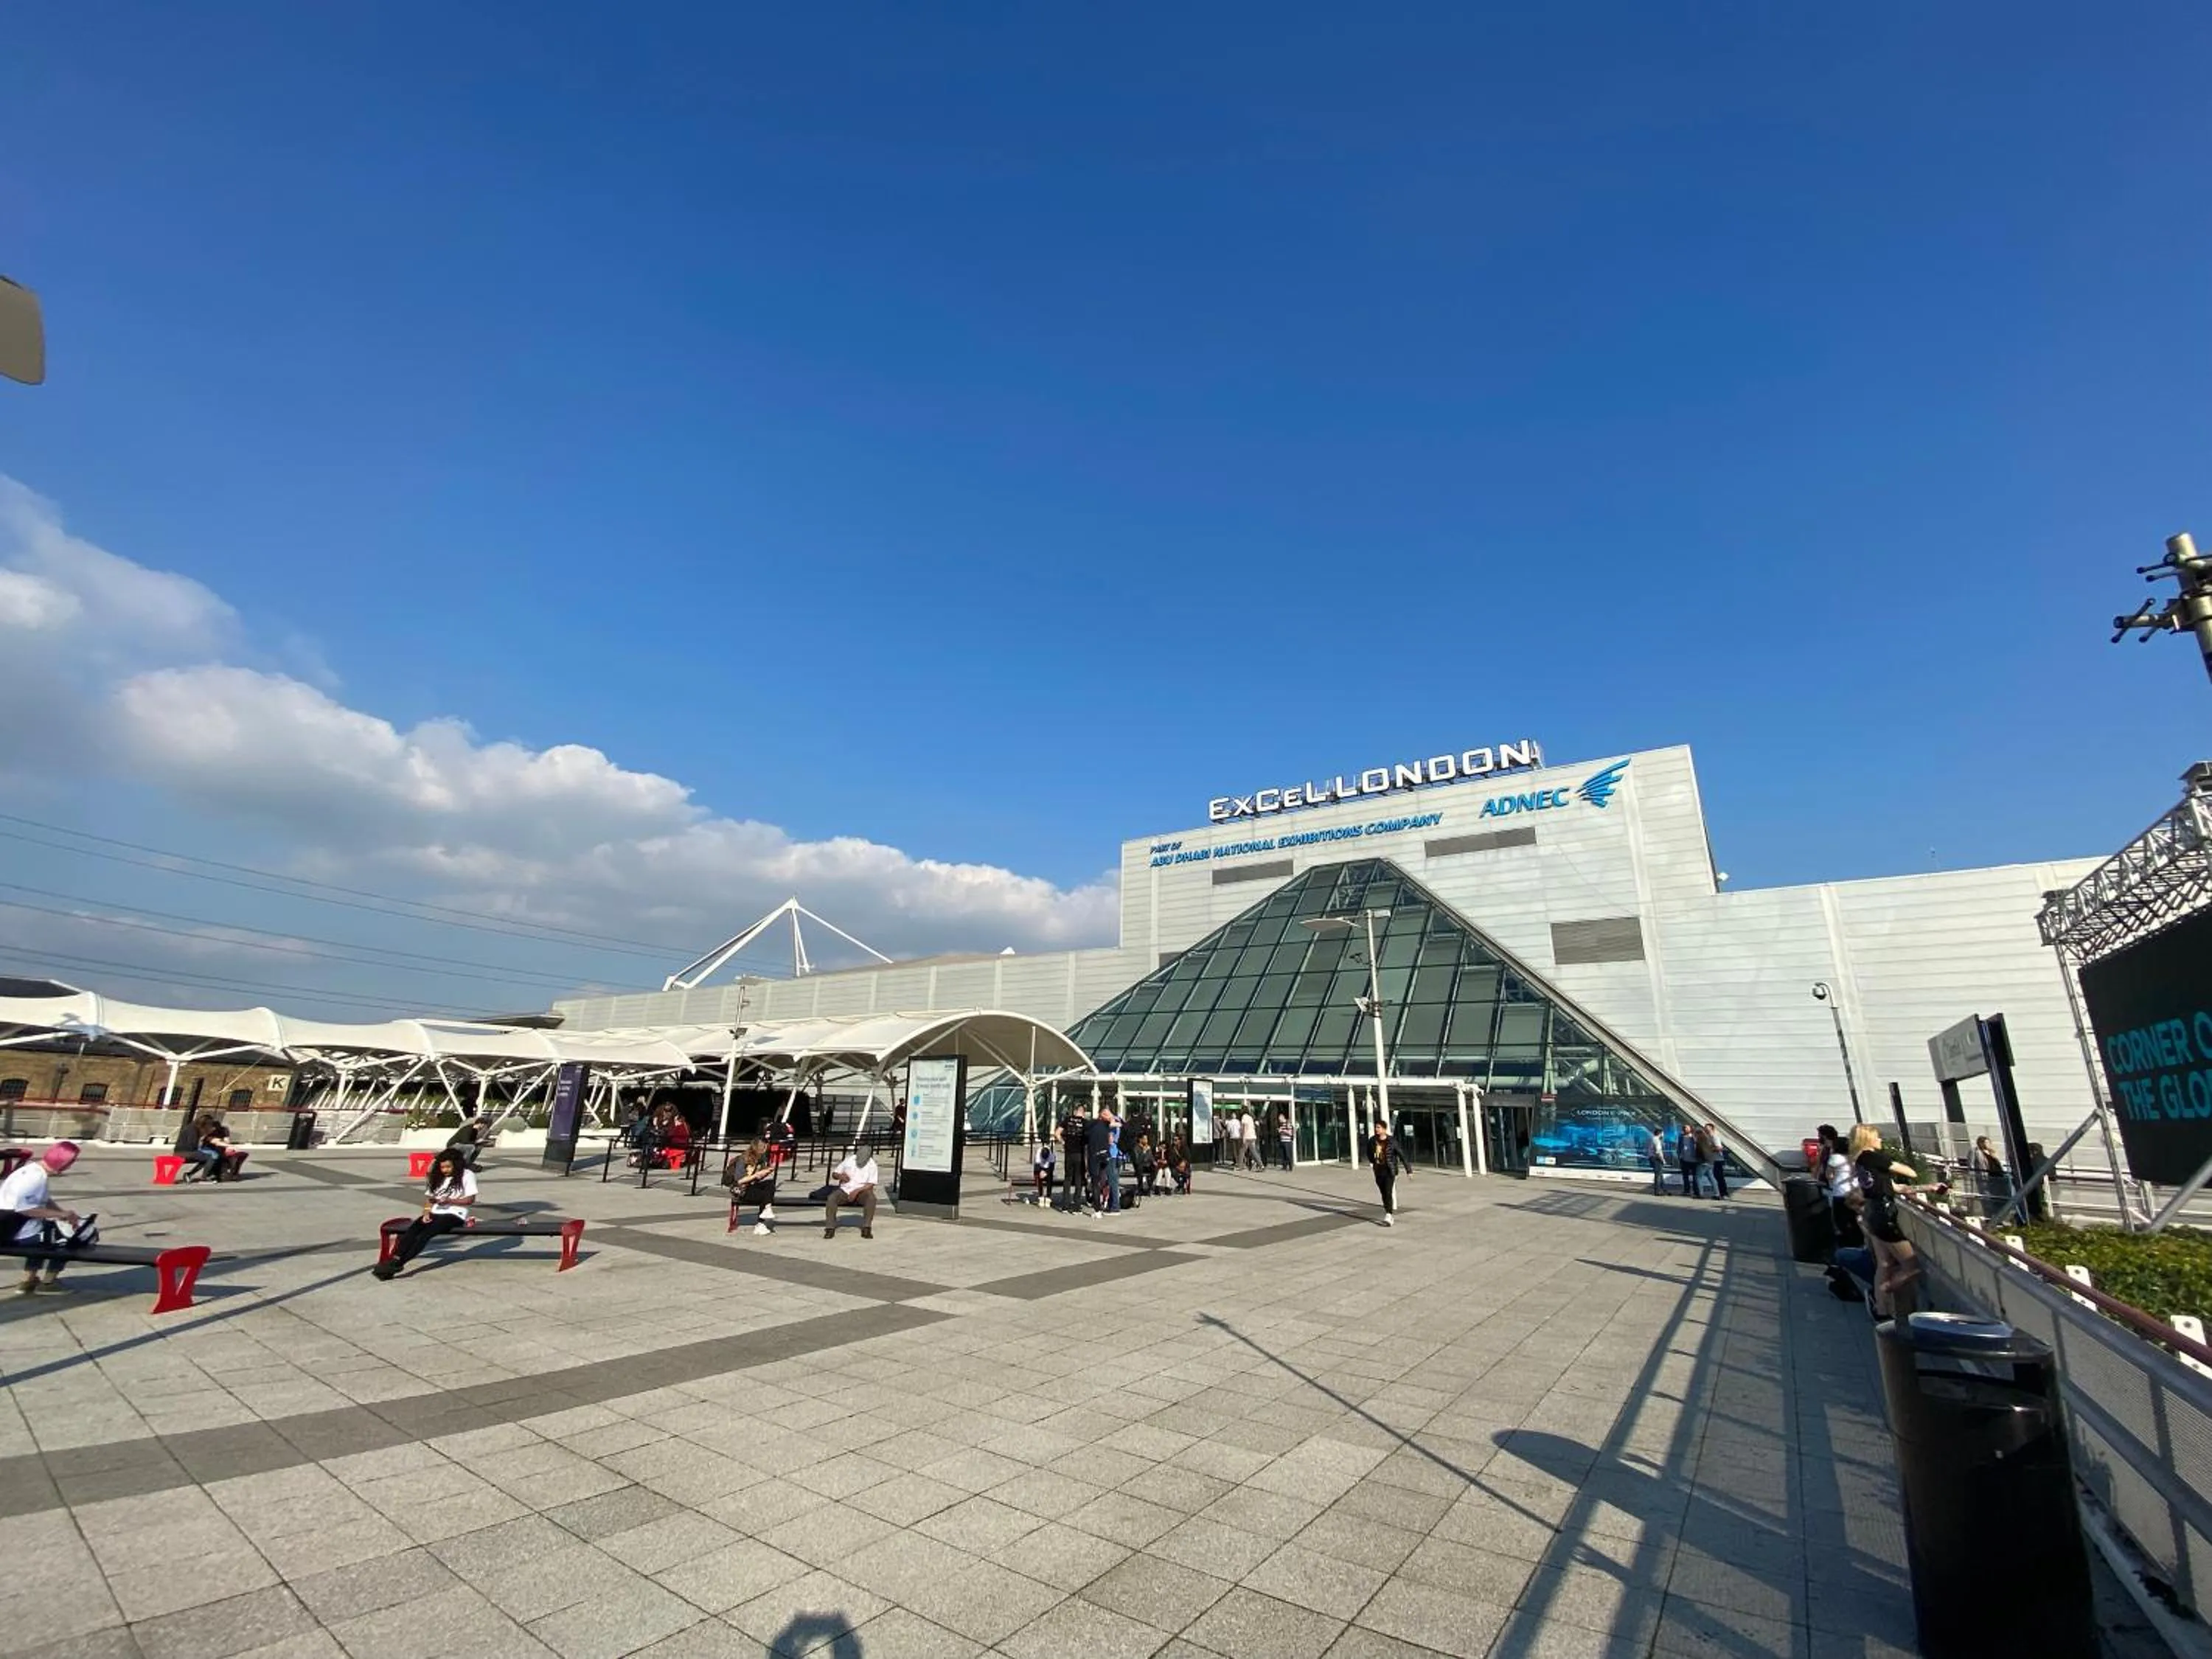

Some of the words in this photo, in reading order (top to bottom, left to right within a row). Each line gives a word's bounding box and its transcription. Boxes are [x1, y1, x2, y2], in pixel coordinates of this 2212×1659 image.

[1335, 739, 1532, 799] LONDON
[1479, 787, 1569, 818] ADNEC
[1150, 854, 1174, 867] ABU
[1175, 849, 1211, 864] DHABI
[1214, 838, 1275, 858] NATIONAL
[1278, 825, 1363, 848] EXHIBITIONS
[1365, 813, 1443, 835] COMPANY
[2107, 1018, 2194, 1074] CORNER
[272, 1077, 286, 1089] K
[2118, 1077, 2160, 1120] THE
[2160, 1069, 2212, 1119] GLO
